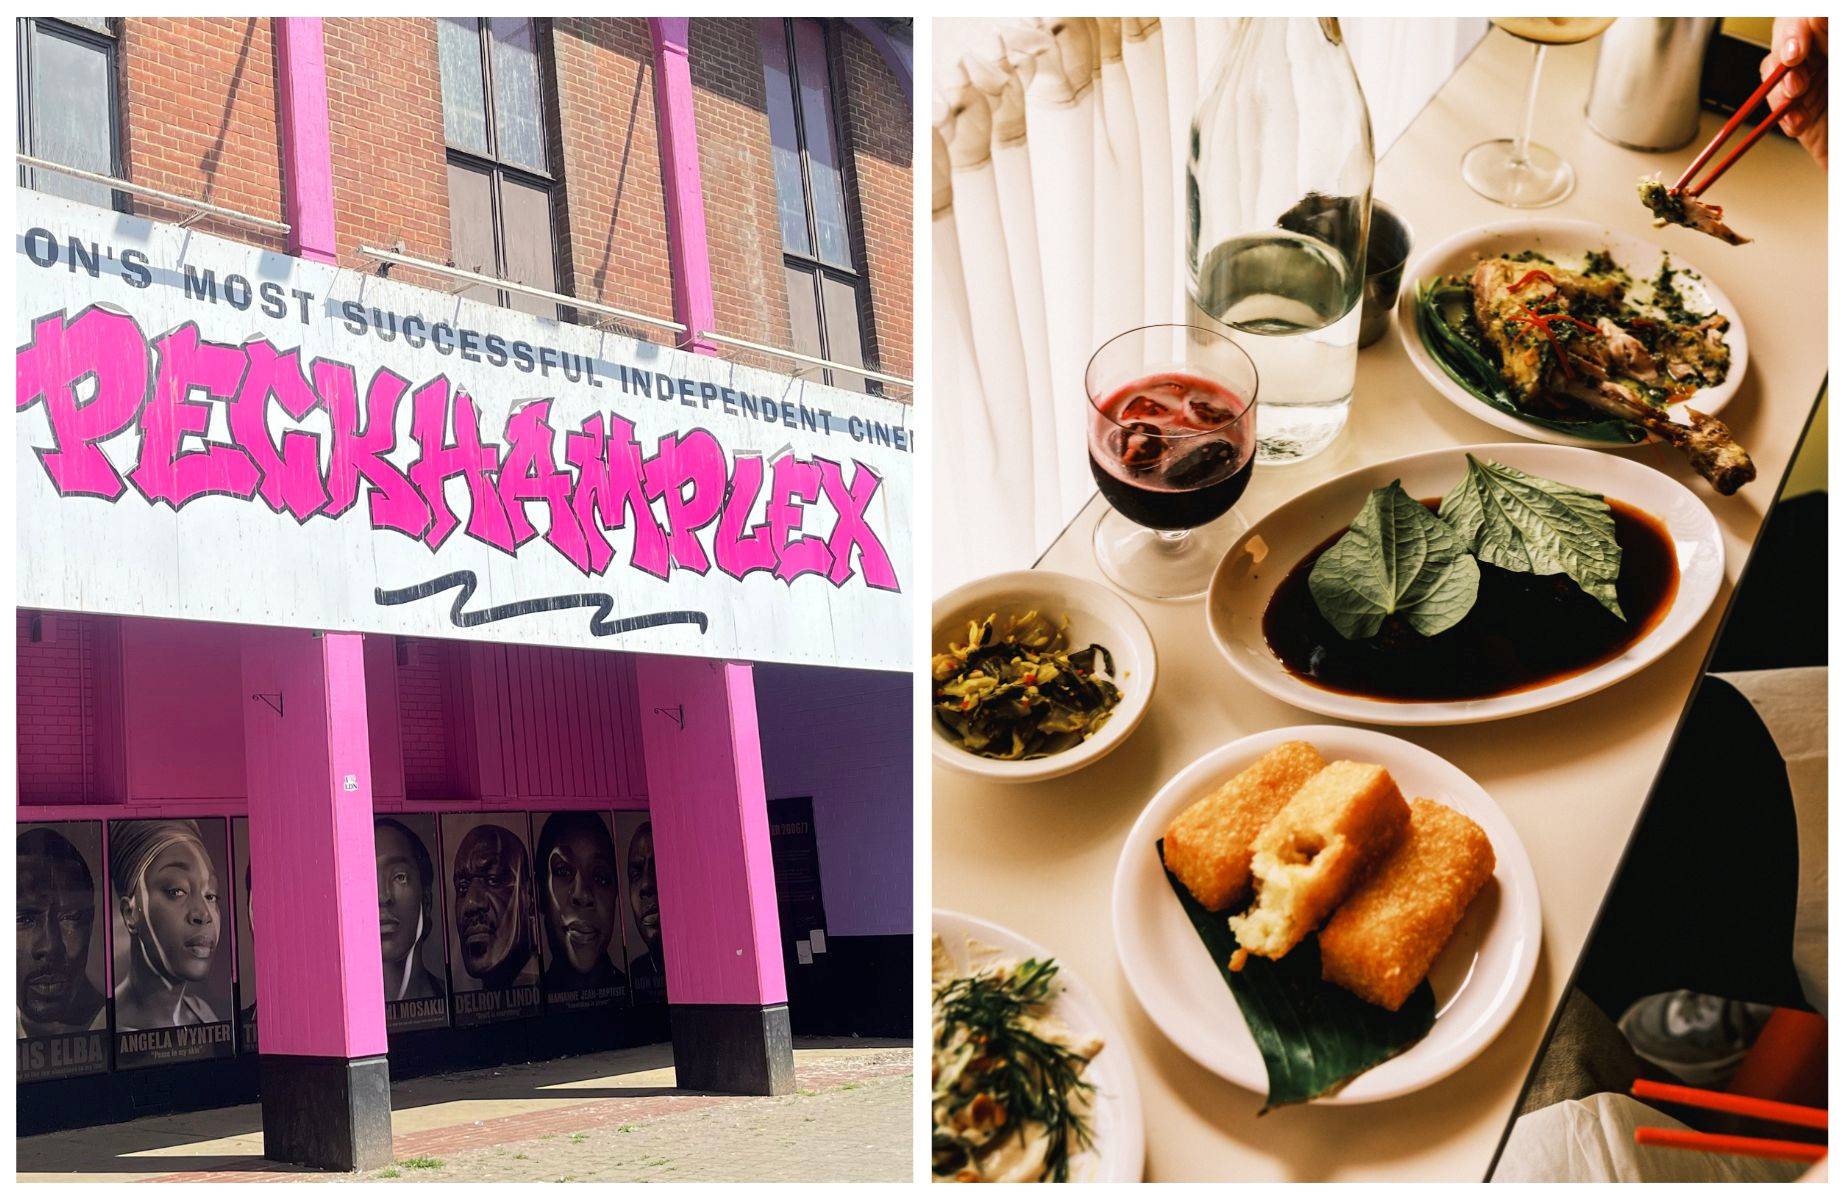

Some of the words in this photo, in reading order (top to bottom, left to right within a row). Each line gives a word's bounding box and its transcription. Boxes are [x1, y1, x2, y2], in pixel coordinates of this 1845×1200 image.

[24, 227, 152, 289] ON'S
[184, 263, 314, 325] MOST
[342, 301, 602, 388] SUCCESSFUL
[620, 364, 831, 435] INDEPENDENT
[16, 301, 901, 594] PECKHAMPLEX
[400, 998, 445, 1019] MOSAKU
[455, 990, 501, 1013] DELROY
[506, 986, 541, 1009] LINDO
[50, 1035, 102, 1065] ELBA
[120, 1031, 173, 1054] ANGELA
[176, 1024, 231, 1049] WYNTER
